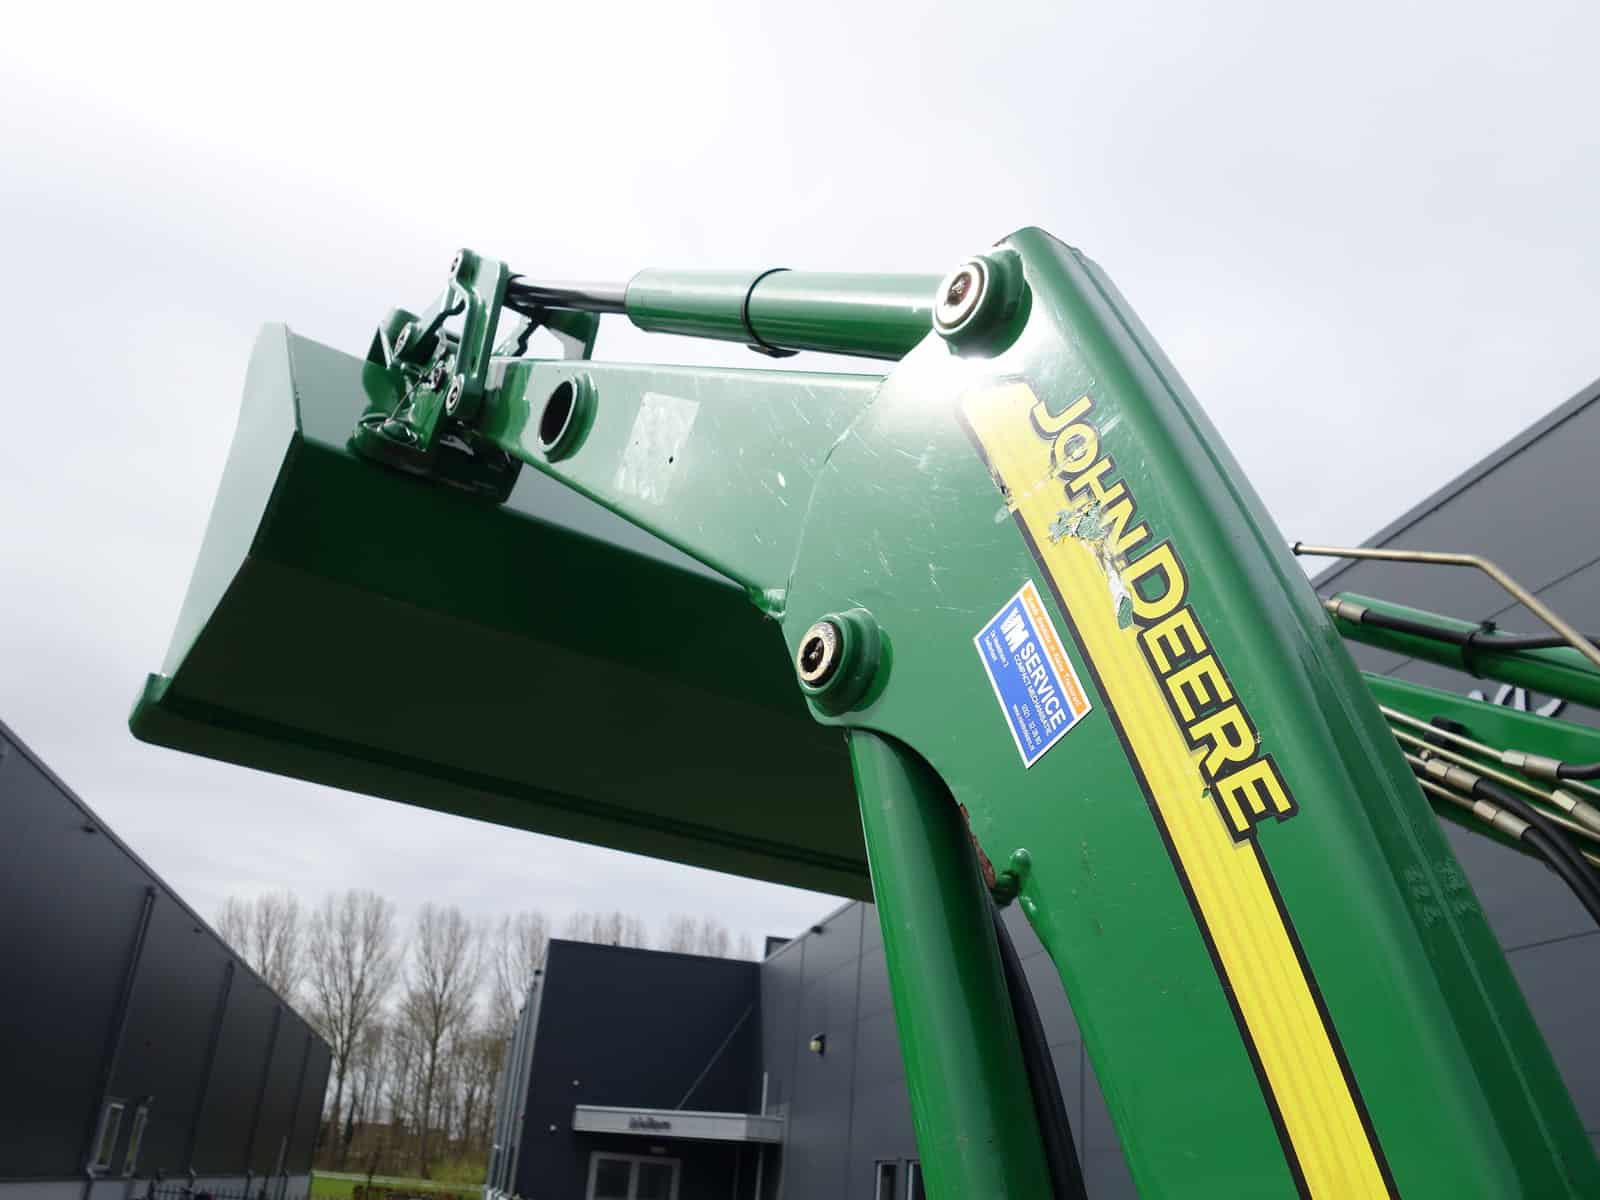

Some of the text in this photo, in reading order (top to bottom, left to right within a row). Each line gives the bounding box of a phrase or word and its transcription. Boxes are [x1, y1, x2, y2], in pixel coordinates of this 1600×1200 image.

[1021, 641, 1067, 731] SERVICE
[1031, 396, 1295, 838] JOHN DEERE
